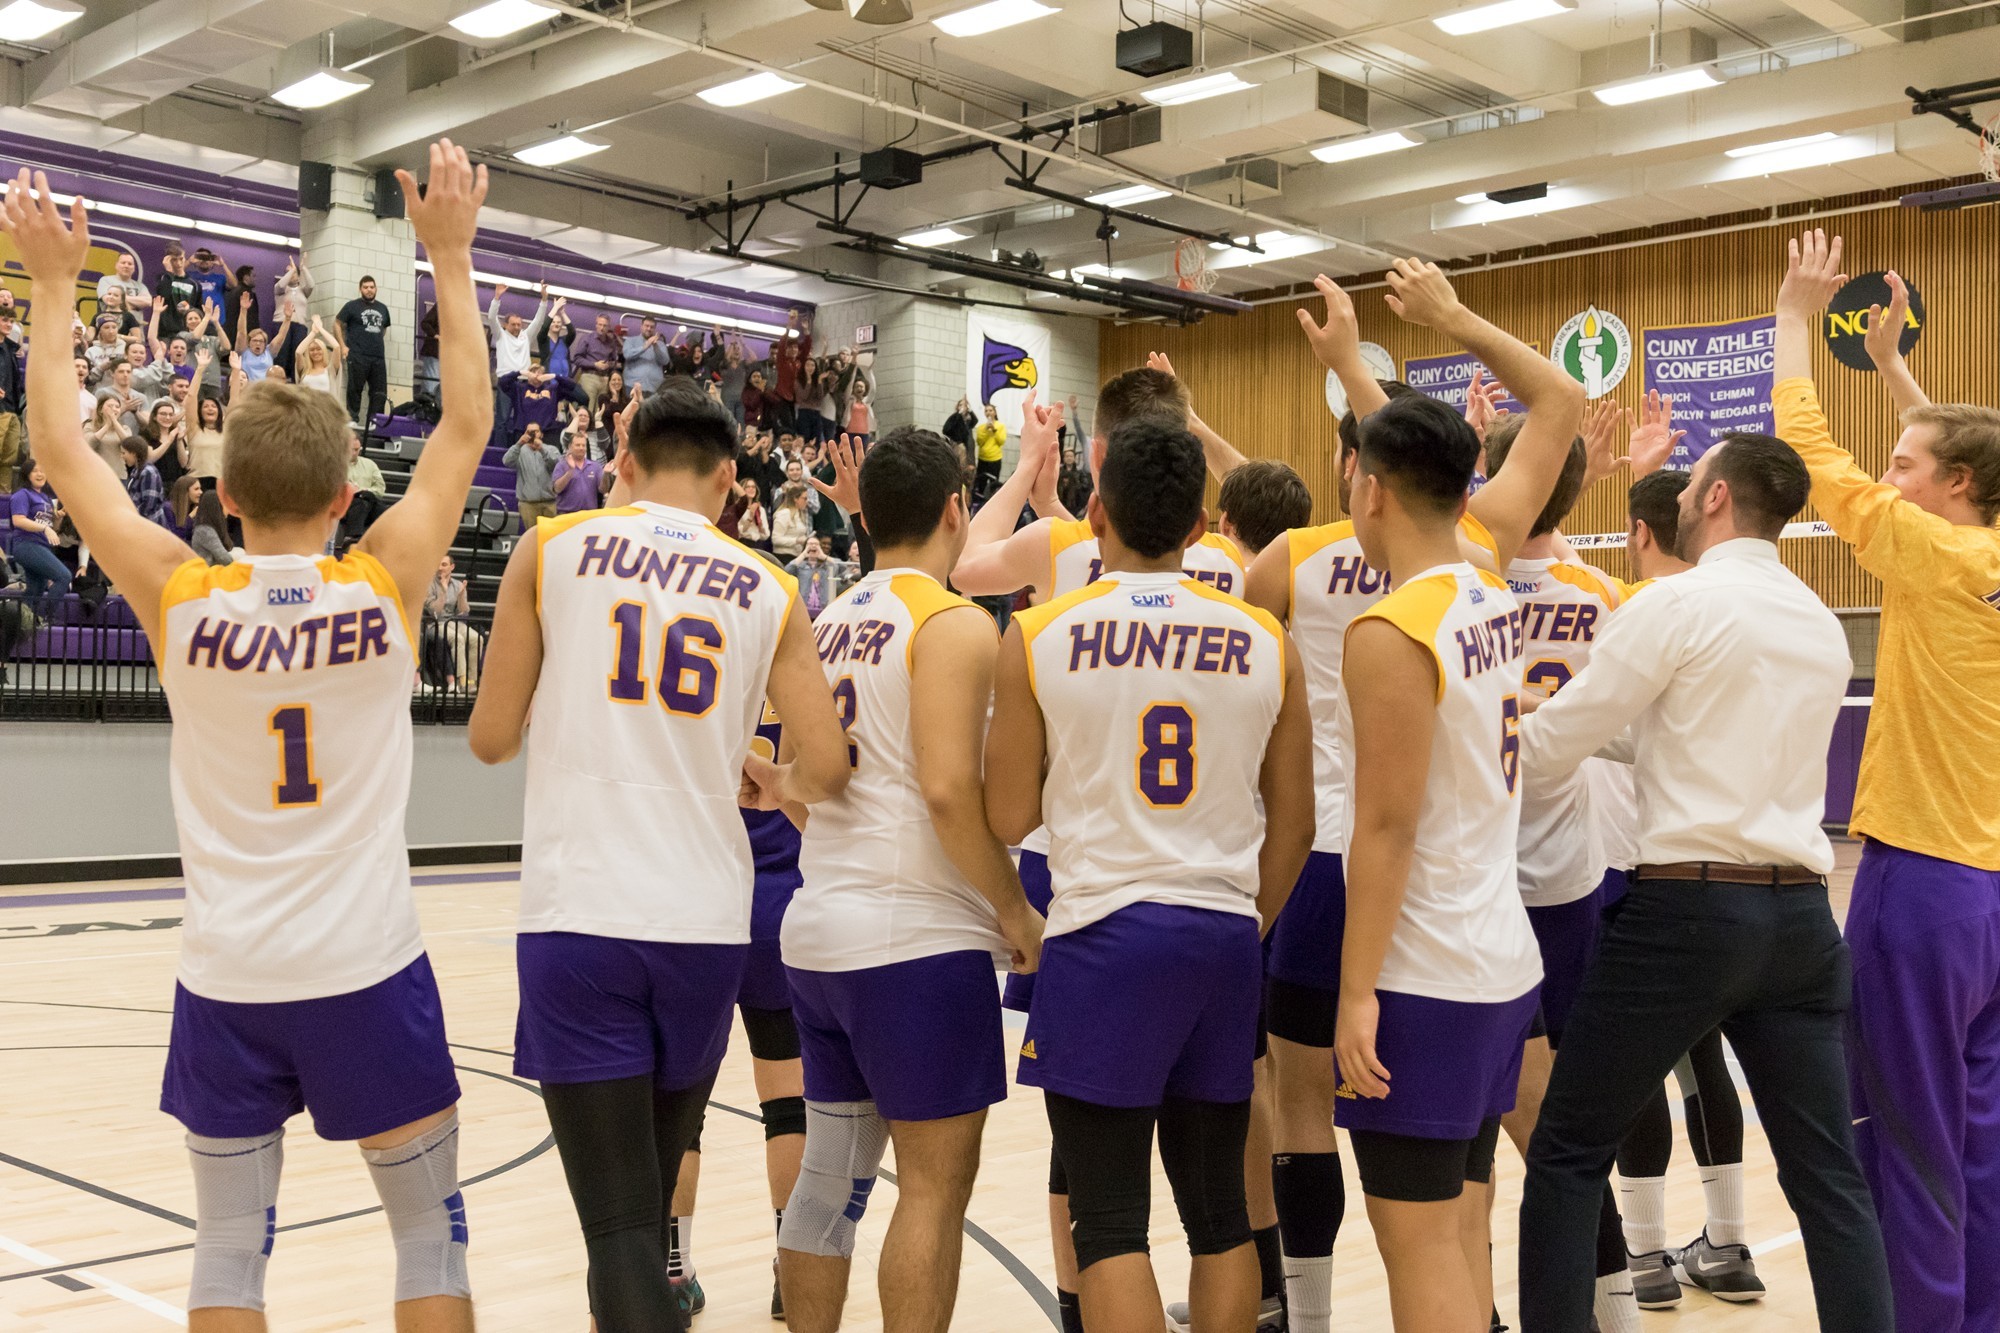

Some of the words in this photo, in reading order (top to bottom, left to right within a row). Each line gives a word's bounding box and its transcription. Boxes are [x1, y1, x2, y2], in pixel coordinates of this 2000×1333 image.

[1553, 318, 1579, 366] ONFERENCE
[1604, 315, 1629, 348] EASTERN
[1647, 338, 1698, 357] CUNY
[1705, 327, 1777, 355] ATHLET
[1408, 367, 1442, 385] CUNY
[1655, 351, 1774, 379] CONFERENC
[1710, 386, 1755, 402] LEHMAN
[1710, 406, 1757, 420] MEDGAR
[1759, 402, 1773, 414] EV
[1734, 421, 1764, 433] TECH
[653, 525, 698, 541] CUNY
[1606, 535, 1628, 544] HAW
[576, 535, 761, 610] HUNTER
[1506, 579, 1542, 593] CUNY
[267, 586, 316, 606] CUNY
[850, 591, 876, 606] CUN
[1131, 594, 1175, 608] CUNY
[186, 606, 391, 673] HUNTER
[1067, 620, 1252, 676] HUNTER
[1454, 609, 1524, 680] HUNTE
[607, 597, 727, 720] 16
[266, 702, 323, 810] 1
[1135, 701, 1198, 810] 8
